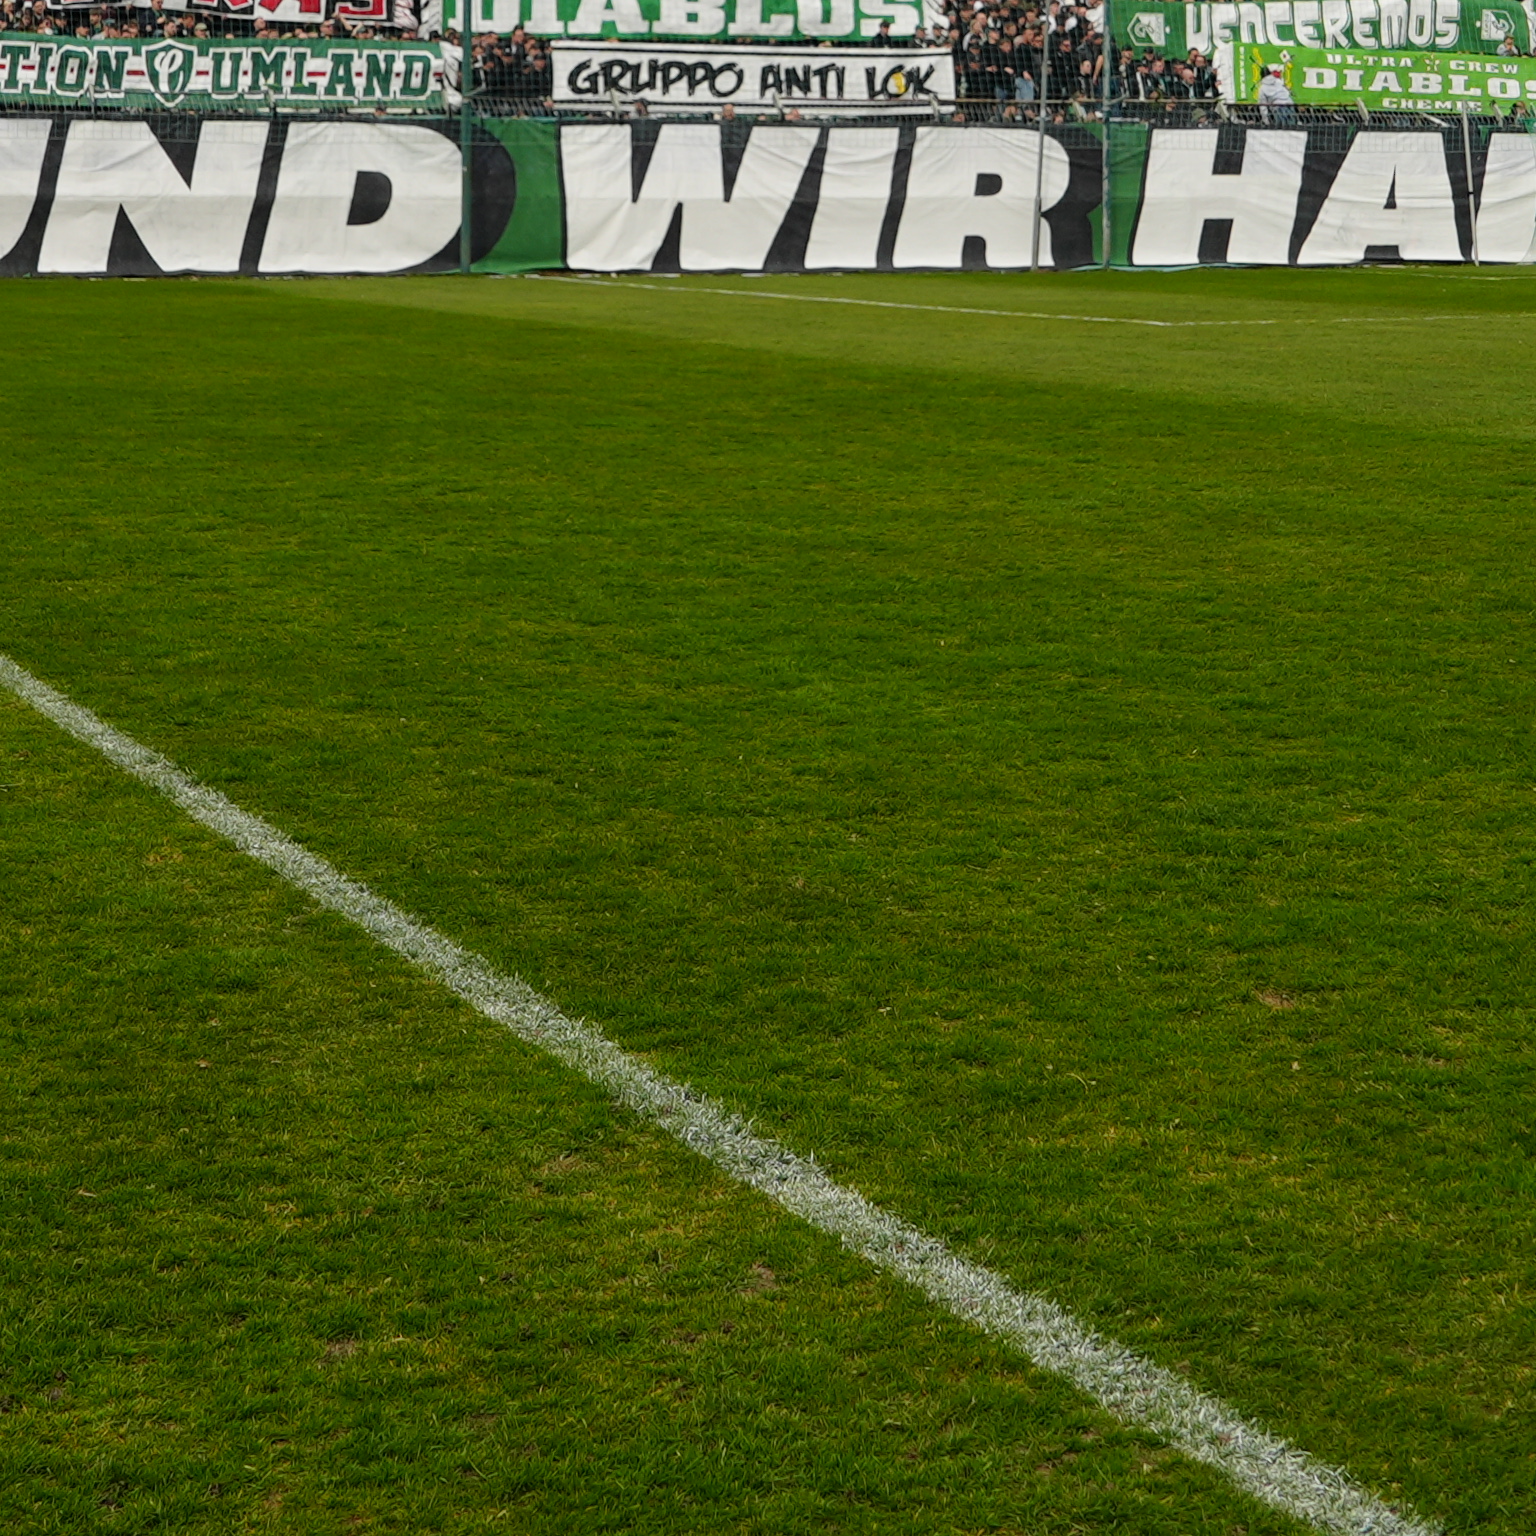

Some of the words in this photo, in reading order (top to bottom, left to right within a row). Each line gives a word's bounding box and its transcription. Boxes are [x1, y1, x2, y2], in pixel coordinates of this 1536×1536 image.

[209, 46, 435, 101] UMLAND
[568, 58, 743, 97] GRUPPO
[760, 62, 845, 100] ANTI
[865, 64, 937, 100] LOK
[1326, 53, 1412, 68] ULTRA
[1449, 60, 1518, 74] CREW
[1381, 97, 1483, 112] CHEMIE
[560, 123, 1071, 271] WIR
